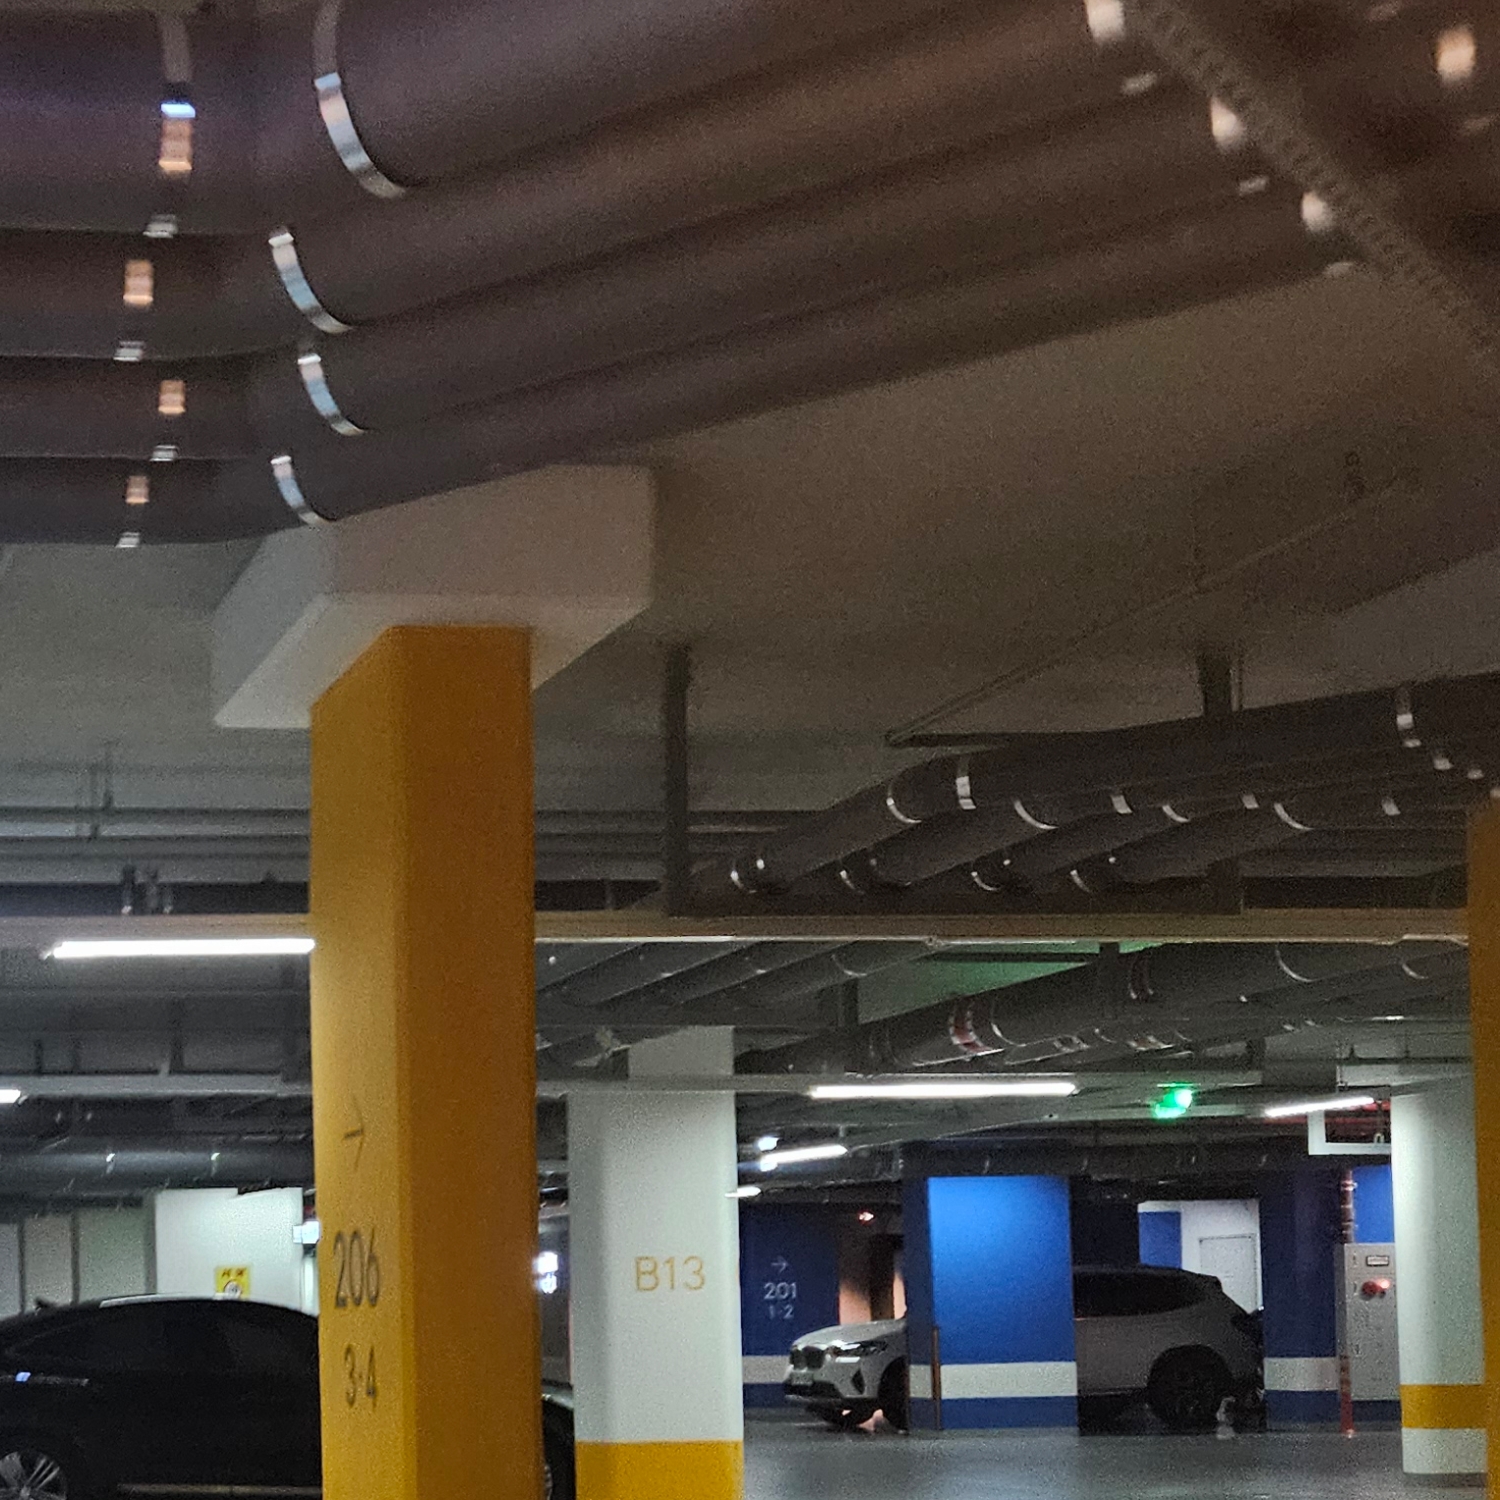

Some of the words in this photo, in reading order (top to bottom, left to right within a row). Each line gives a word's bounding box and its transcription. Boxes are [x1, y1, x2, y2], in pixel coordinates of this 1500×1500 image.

[334, 1229, 379, 1308] 206
[635, 1255, 705, 1291] B13
[763, 1282, 796, 1299] 201
